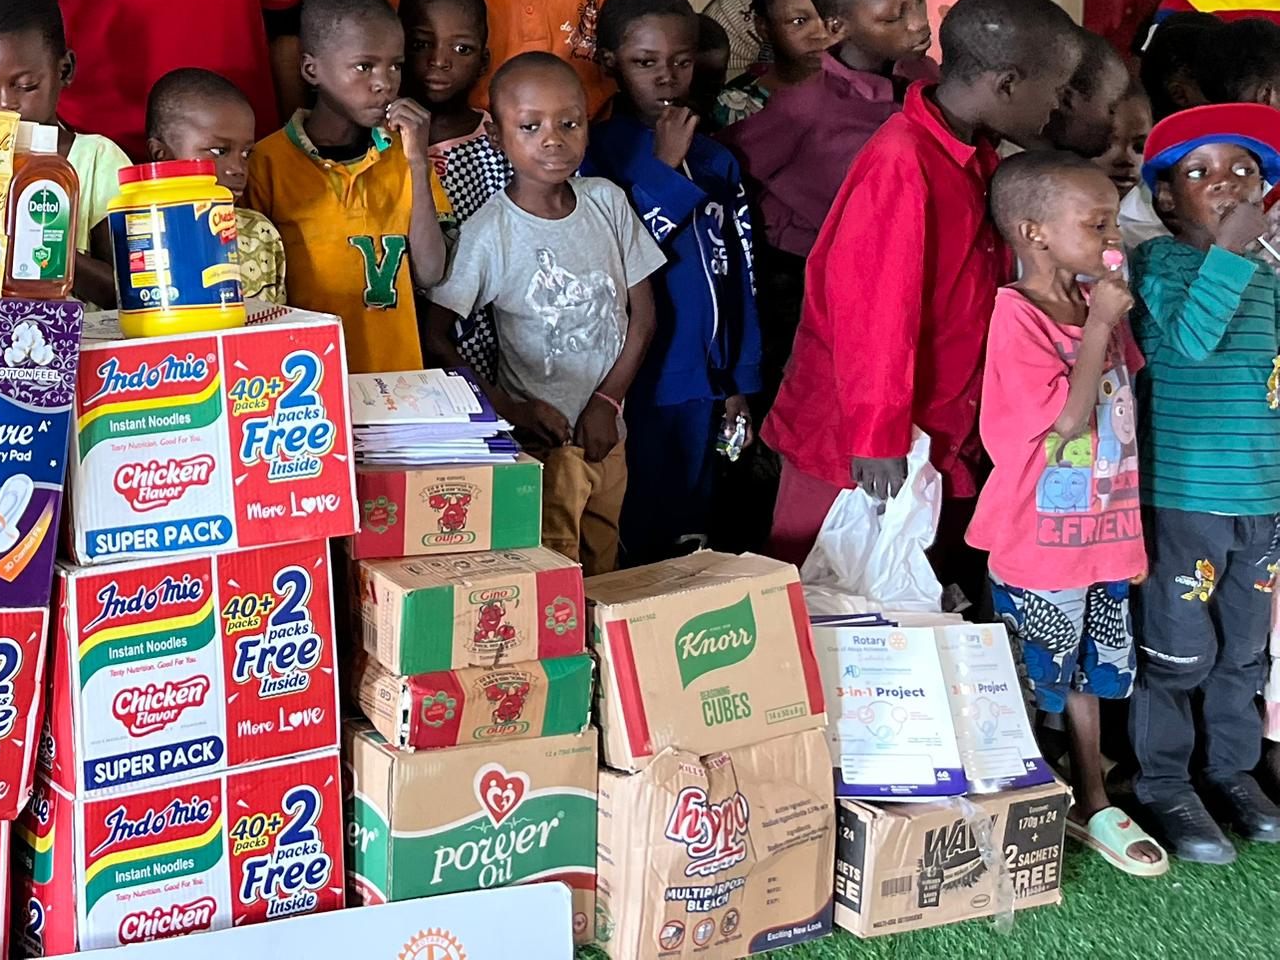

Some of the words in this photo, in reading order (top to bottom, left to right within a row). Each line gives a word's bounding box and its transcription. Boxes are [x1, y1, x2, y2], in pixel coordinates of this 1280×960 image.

[29, 200, 59, 213] Dettol
[349, 234, 407, 308] V
[33, 369, 61, 381] FEEL
[83, 353, 207, 405] Indomie
[234, 398, 267, 414] packs
[275, 407, 320, 425] packs
[109, 415, 147, 433] Instant
[148, 411, 191, 427] Noodles
[243, 420, 330, 459] Free
[9, 448, 32, 462] Pad
[270, 455, 319, 476] Inside
[117, 456, 212, 489] Chicken
[138, 485, 183, 503] Flavor
[246, 502, 286, 520] More
[290, 492, 340, 518] Love
[95, 527, 161, 554] SUPER
[163, 519, 225, 546] PACK
[435, 533, 464, 543] Gino
[82, 574, 203, 633] Indomie
[480, 589, 508, 601] Gino
[227, 617, 260, 633] packs
[268, 622, 310, 642] packs
[108, 640, 144, 660] Instant
[145, 635, 188, 652] Noodles
[678, 627, 754, 660] Knorr
[853, 635, 887, 647] Rotary
[157, 659, 174, 670] Good
[236, 637, 319, 679] Free
[260, 673, 308, 695] Inside
[699, 685, 731, 701] SEASONING
[836, 686, 873, 697] 3-in-1
[876, 686, 926, 700] Project
[977, 681, 1009, 694] Project
[116, 676, 210, 716] Chicken
[135, 708, 180, 726] Flavor
[701, 691, 752, 728] CUBES
[237, 718, 274, 739] More
[278, 705, 326, 733] Love
[486, 725, 517, 735] Gino
[94, 756, 156, 785] SUPER
[159, 739, 217, 773] PACK
[678, 762, 705, 777] KILLS
[92, 794, 212, 857] Indomie
[668, 789, 749, 855] hypo
[1018, 815, 1038, 831] 170g
[1045, 810, 1057, 823] 24
[842, 827, 855, 841] 24
[924, 814, 999, 868] WA
[234, 837, 267, 855] packs
[275, 841, 319, 862] packs
[430, 816, 560, 885] power
[1004, 844, 1019, 868] 2
[1018, 844, 1060, 867] SACHETS
[115, 863, 152, 884] Instant
[153, 856, 195, 876] Noodles
[244, 857, 328, 899] Free
[478, 857, 514, 888] Oil
[1009, 862, 1059, 891] FREE
[269, 893, 316, 916] Inside
[686, 893, 730, 912] BLEACH
[121, 898, 216, 941] Chicken
[767, 927, 792, 942] Exciting
[793, 924, 807, 938] New
[807, 921, 823, 934] Look
